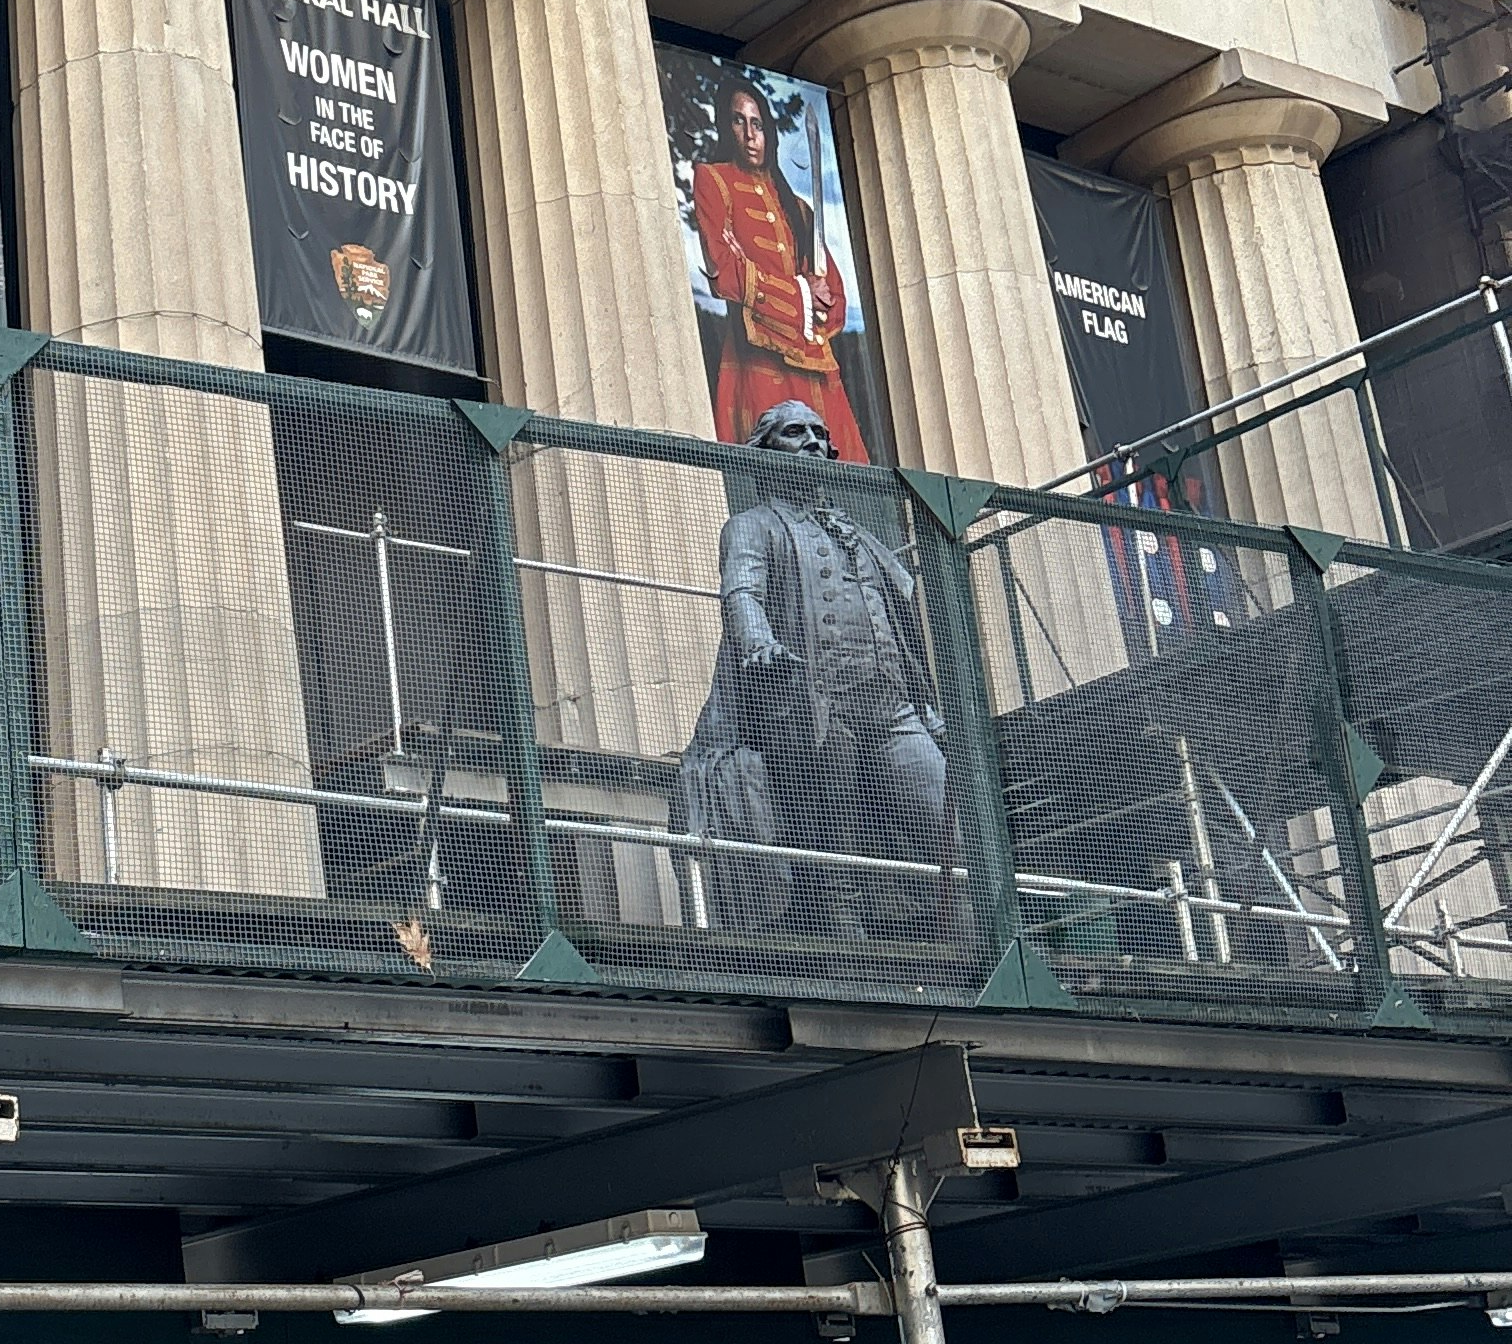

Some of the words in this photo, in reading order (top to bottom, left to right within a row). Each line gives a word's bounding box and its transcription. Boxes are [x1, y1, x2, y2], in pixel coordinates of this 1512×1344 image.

[280, 38, 397, 104] WOMEN
[315, 95, 335, 121] IN
[338, 101, 375, 131] THE
[309, 121, 357, 154] FACE
[360, 135, 384, 160] OF
[286, 151, 418, 216] HISTORY
[1054, 270, 1147, 320] AMERICAN
[1081, 309, 1129, 345] FLAG
